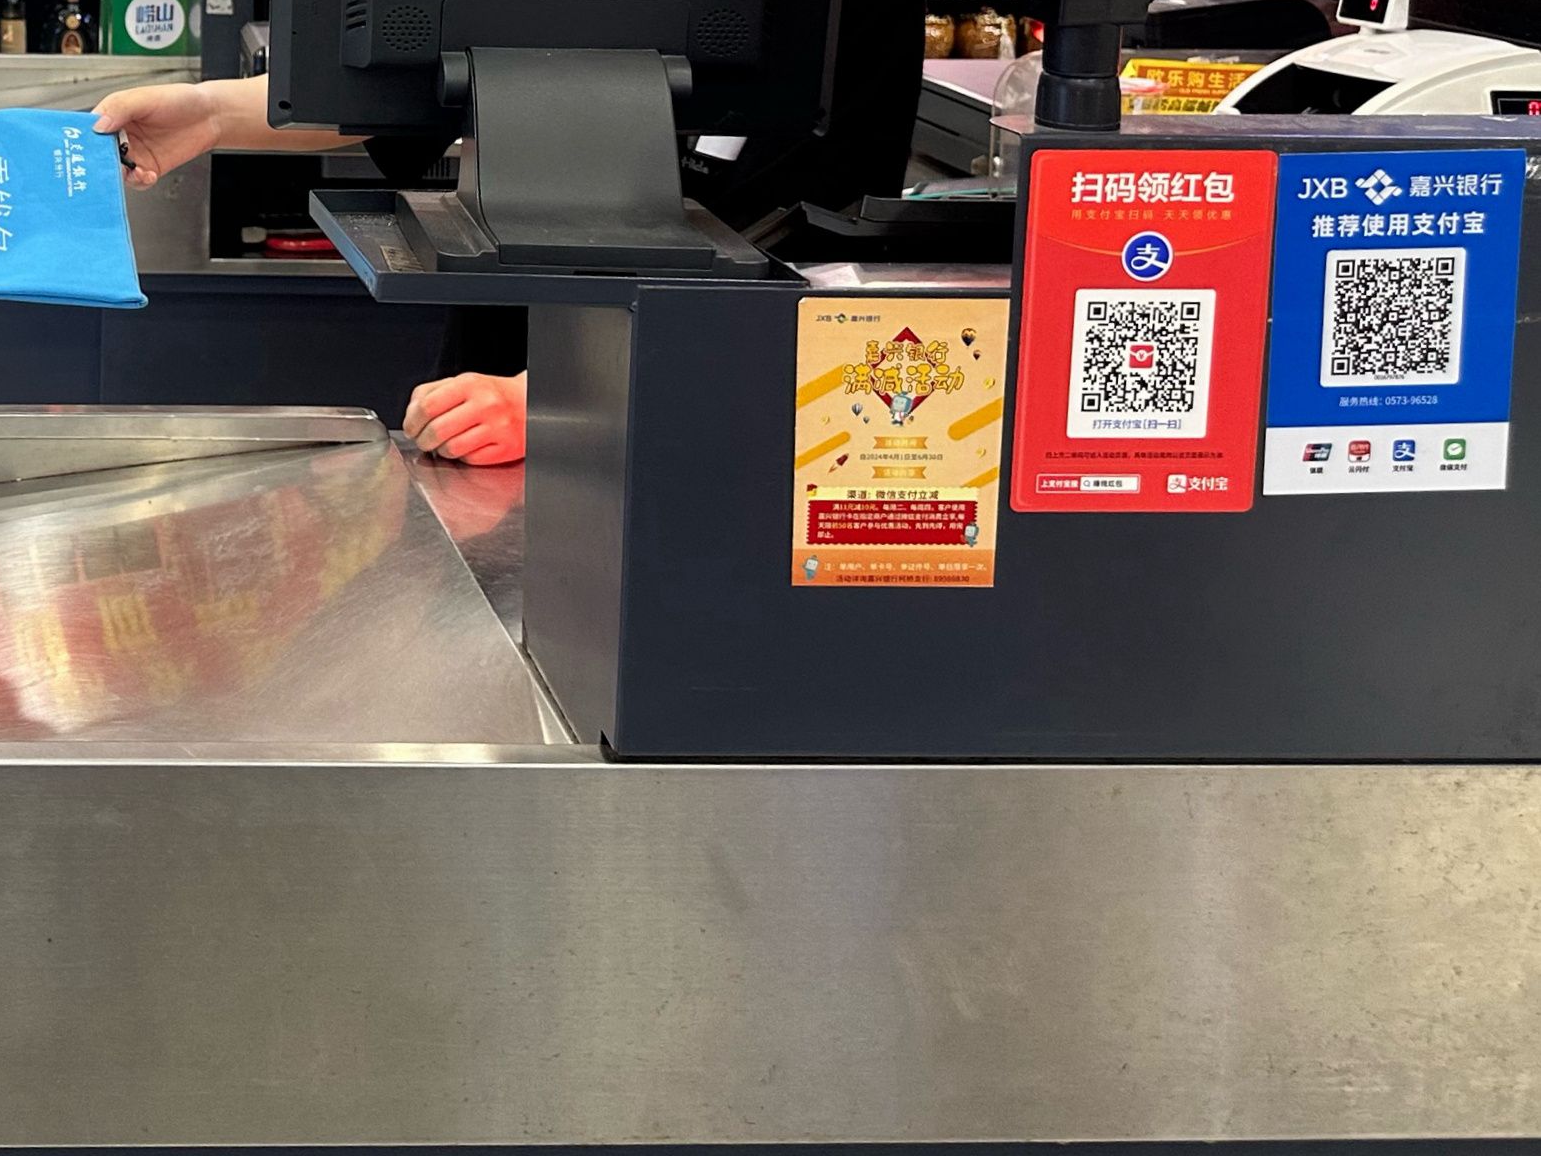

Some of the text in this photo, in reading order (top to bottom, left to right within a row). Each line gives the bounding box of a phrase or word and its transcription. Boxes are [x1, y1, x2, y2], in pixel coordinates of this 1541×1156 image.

[136, 3, 174, 23] 崂山
[1070, 172, 1235, 204] 扫码领红包
[1297, 177, 1348, 199] JXB
[1409, 174, 1503, 197] 嘉兴银行
[1071, 210, 1154, 221] 用支付宝扫码
[1312, 212, 1486, 238] 推荐使用支付宝
[865, 340, 950, 364] 嘉兴银行
[842, 363, 966, 395] 满减活动
[1187, 476, 1228, 492] 支付宝
